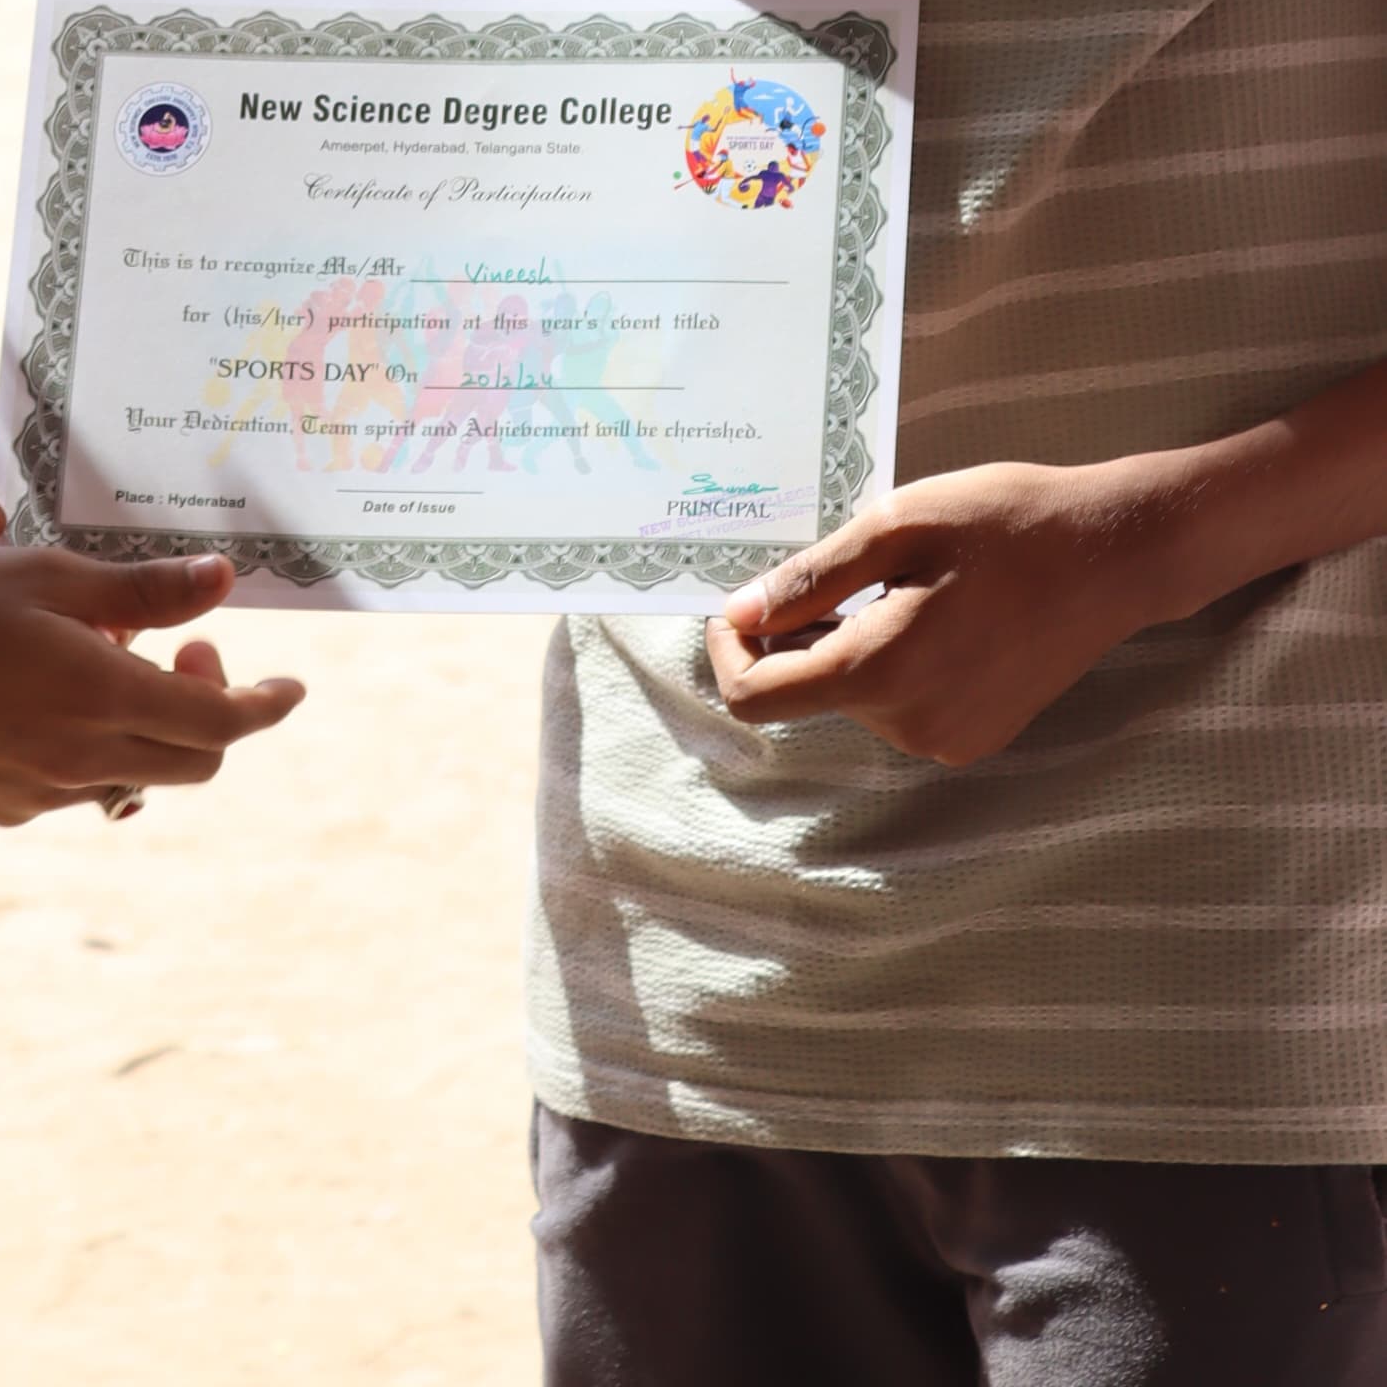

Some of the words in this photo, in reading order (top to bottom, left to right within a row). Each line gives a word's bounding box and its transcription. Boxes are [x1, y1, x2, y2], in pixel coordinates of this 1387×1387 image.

[239, 93, 302, 121] New
[313, 94, 431, 125] Science
[443, 97, 548, 131] Degree
[560, 97, 673, 131] College
[320, 139, 389, 155] Ameerpet,
[393, 140, 469, 156] Hyderabad,
[474, 141, 542, 157] Telangana
[303, 173, 412, 209] Certificate
[418, 178, 444, 211] of
[448, 175, 593, 210] Participation
[122, 248, 170, 273] This
[177, 253, 193, 270] is
[200, 254, 218, 270] to
[224, 257, 316, 279] recognize
[182, 304, 210, 324] for
[223, 305, 315, 329] (his/her)
[328, 310, 451, 334] participation
[463, 313, 481, 330] at
[494, 311, 528, 334] this
[541, 310, 598, 335] year's
[611, 313, 662, 330] event
[674, 313, 720, 330] titled
[208, 357, 316, 381] "SPORTS
[324, 362, 379, 382] DAY"
[385, 364, 418, 383] On
[125, 407, 177, 431] Your
[301, 415, 357, 436] Team
[365, 418, 415, 440] spirit
[421, 421, 458, 438] and
[462, 417, 590, 443] Achievement
[595, 419, 630, 439] will
[636, 419, 659, 439] be
[664, 421, 763, 444] cherished.
[115, 490, 154, 504] Place
[167, 493, 247, 509] Hyderabad
[362, 500, 395, 513] Date
[399, 500, 415, 513] of
[418, 501, 456, 514] Issue
[666, 499, 772, 519] PRINCIPAL
